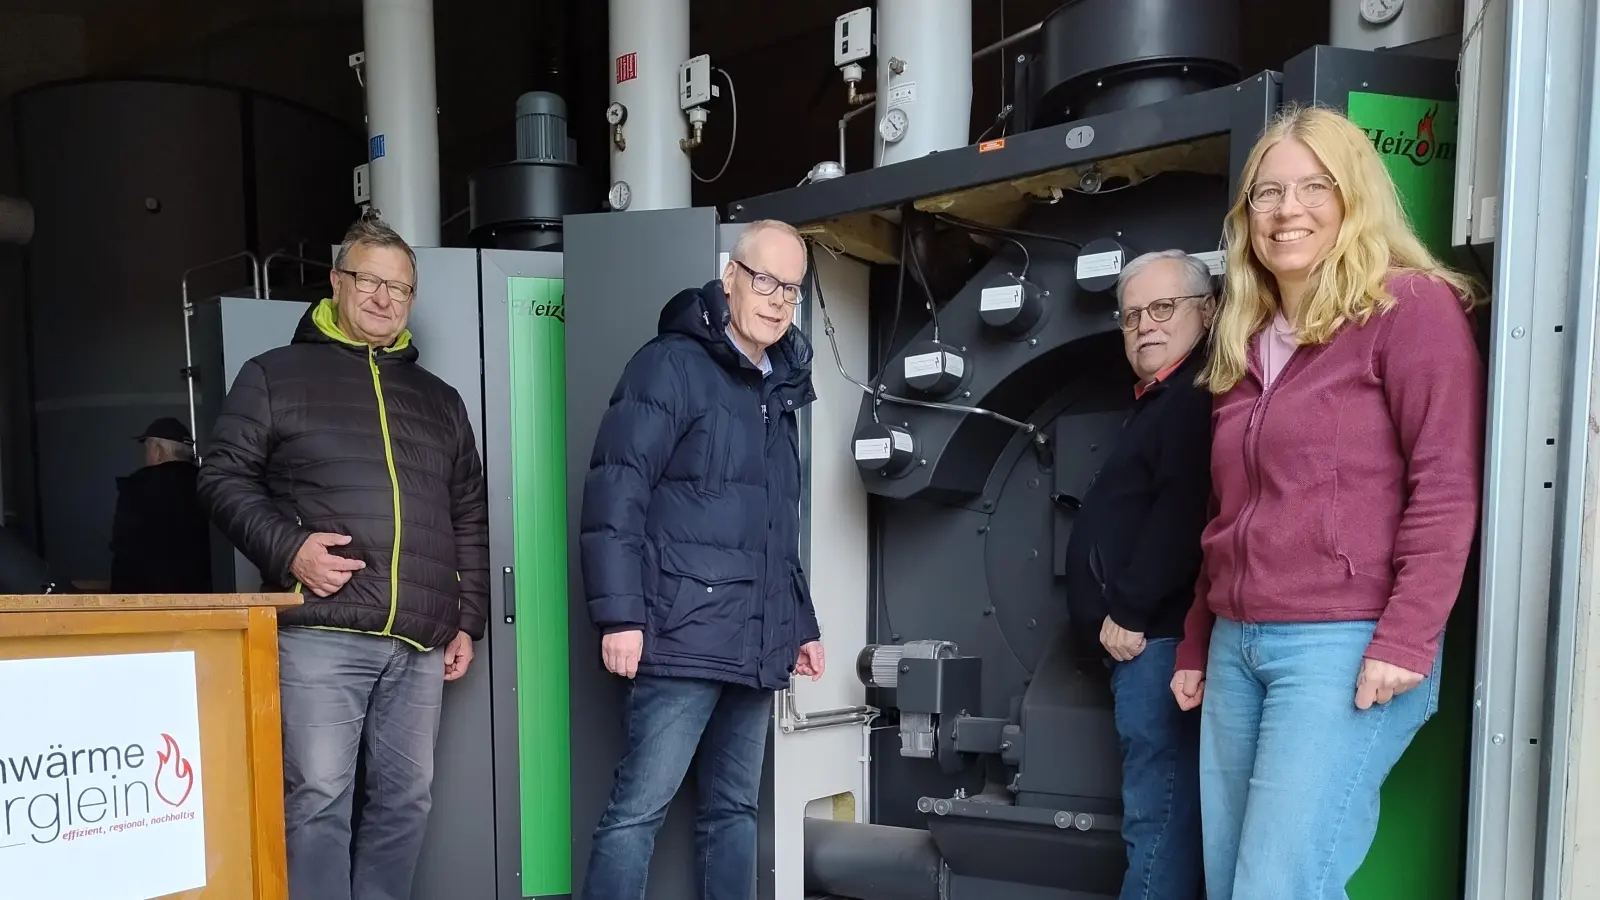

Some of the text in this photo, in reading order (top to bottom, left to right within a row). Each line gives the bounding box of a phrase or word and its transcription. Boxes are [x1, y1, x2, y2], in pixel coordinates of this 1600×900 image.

[1077, 131, 1083, 144] 1
[62, 811, 195, 841] effizient, regional, nachhaltig
